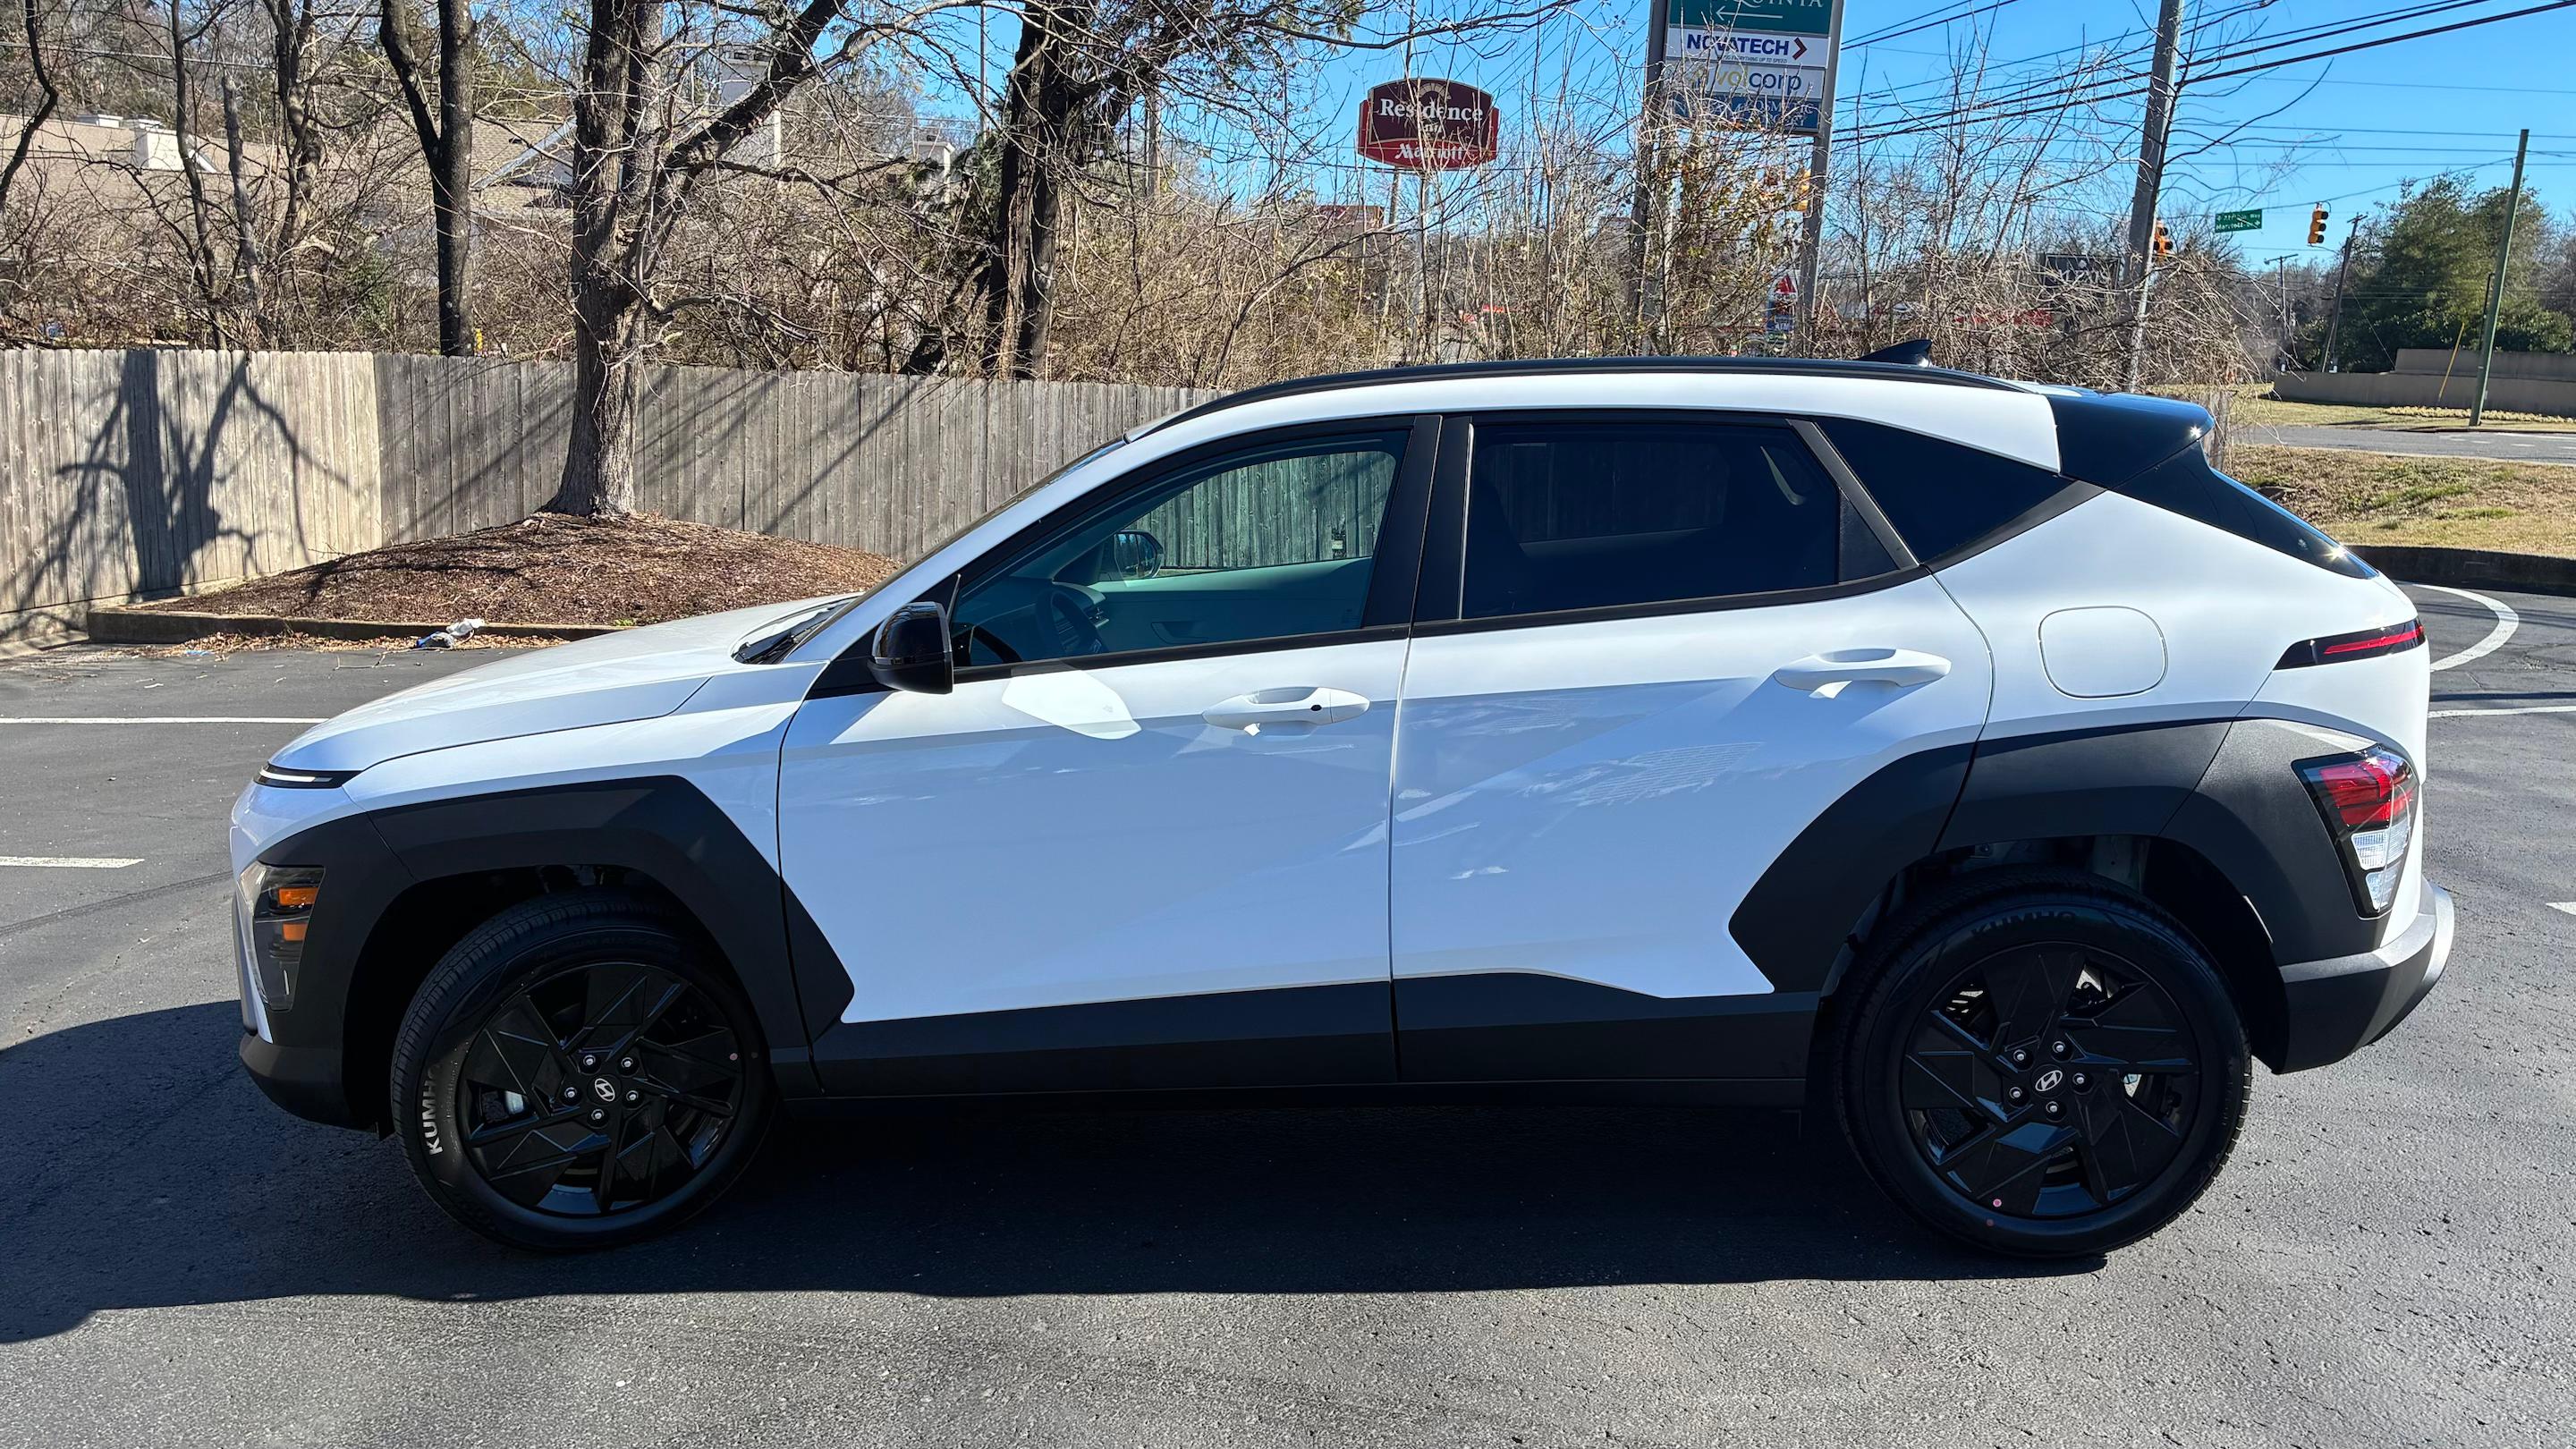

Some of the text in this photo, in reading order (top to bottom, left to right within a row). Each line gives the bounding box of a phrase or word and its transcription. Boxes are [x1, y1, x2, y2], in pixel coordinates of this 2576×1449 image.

[1687, 33, 1790, 55] NOVATECH
[1380, 98, 1484, 121] Resdence
[1970, 911, 2076, 936] KUMHO
[421, 1062, 444, 1156] KUMHO
